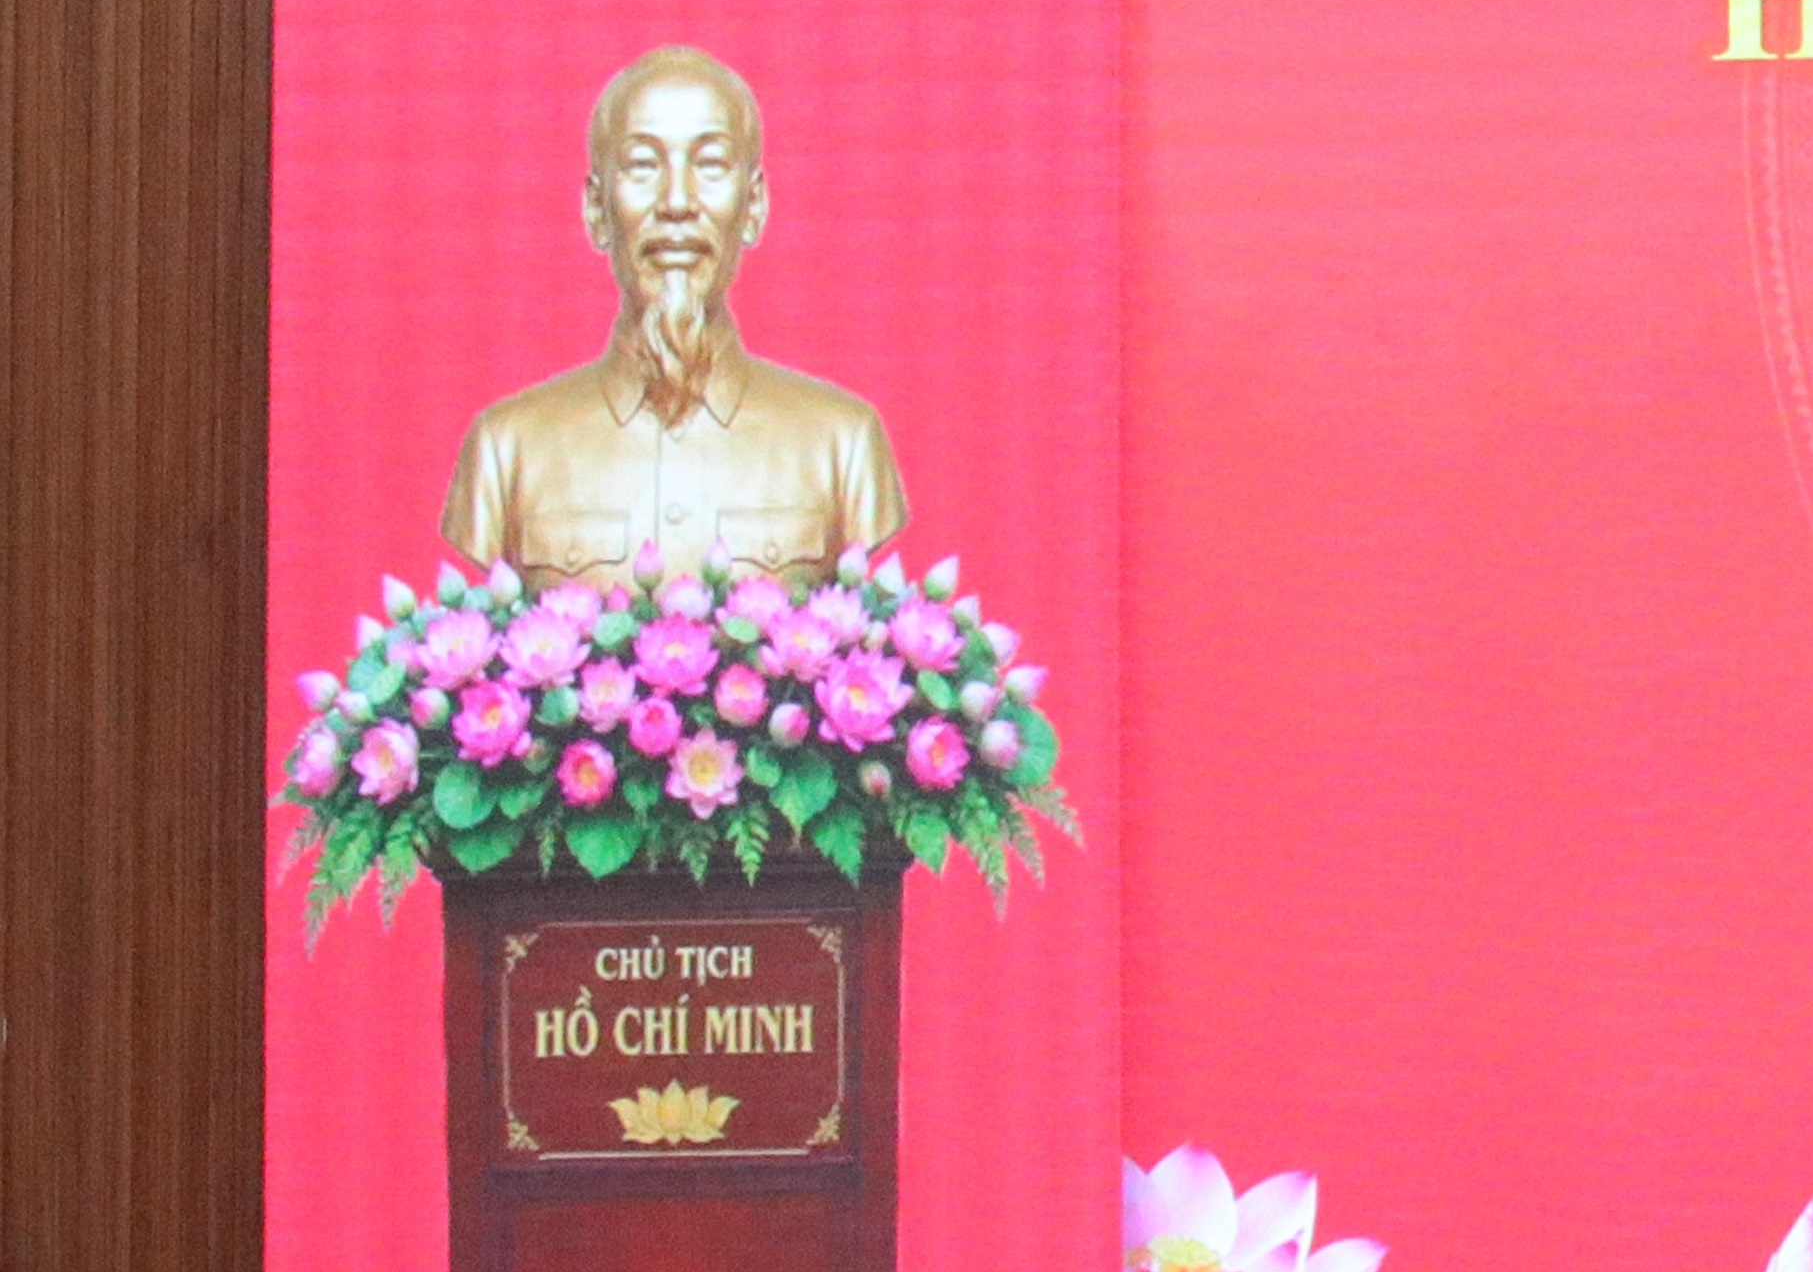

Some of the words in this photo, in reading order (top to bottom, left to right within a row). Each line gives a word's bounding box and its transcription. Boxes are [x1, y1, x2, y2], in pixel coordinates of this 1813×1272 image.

[595, 935, 664, 982] CHỦ
[675, 944, 753, 986] TỊCH
[535, 985, 598, 1057] HỒ
[613, 993, 689, 1056] CHÍ
[704, 1004, 814, 1055] MINH
